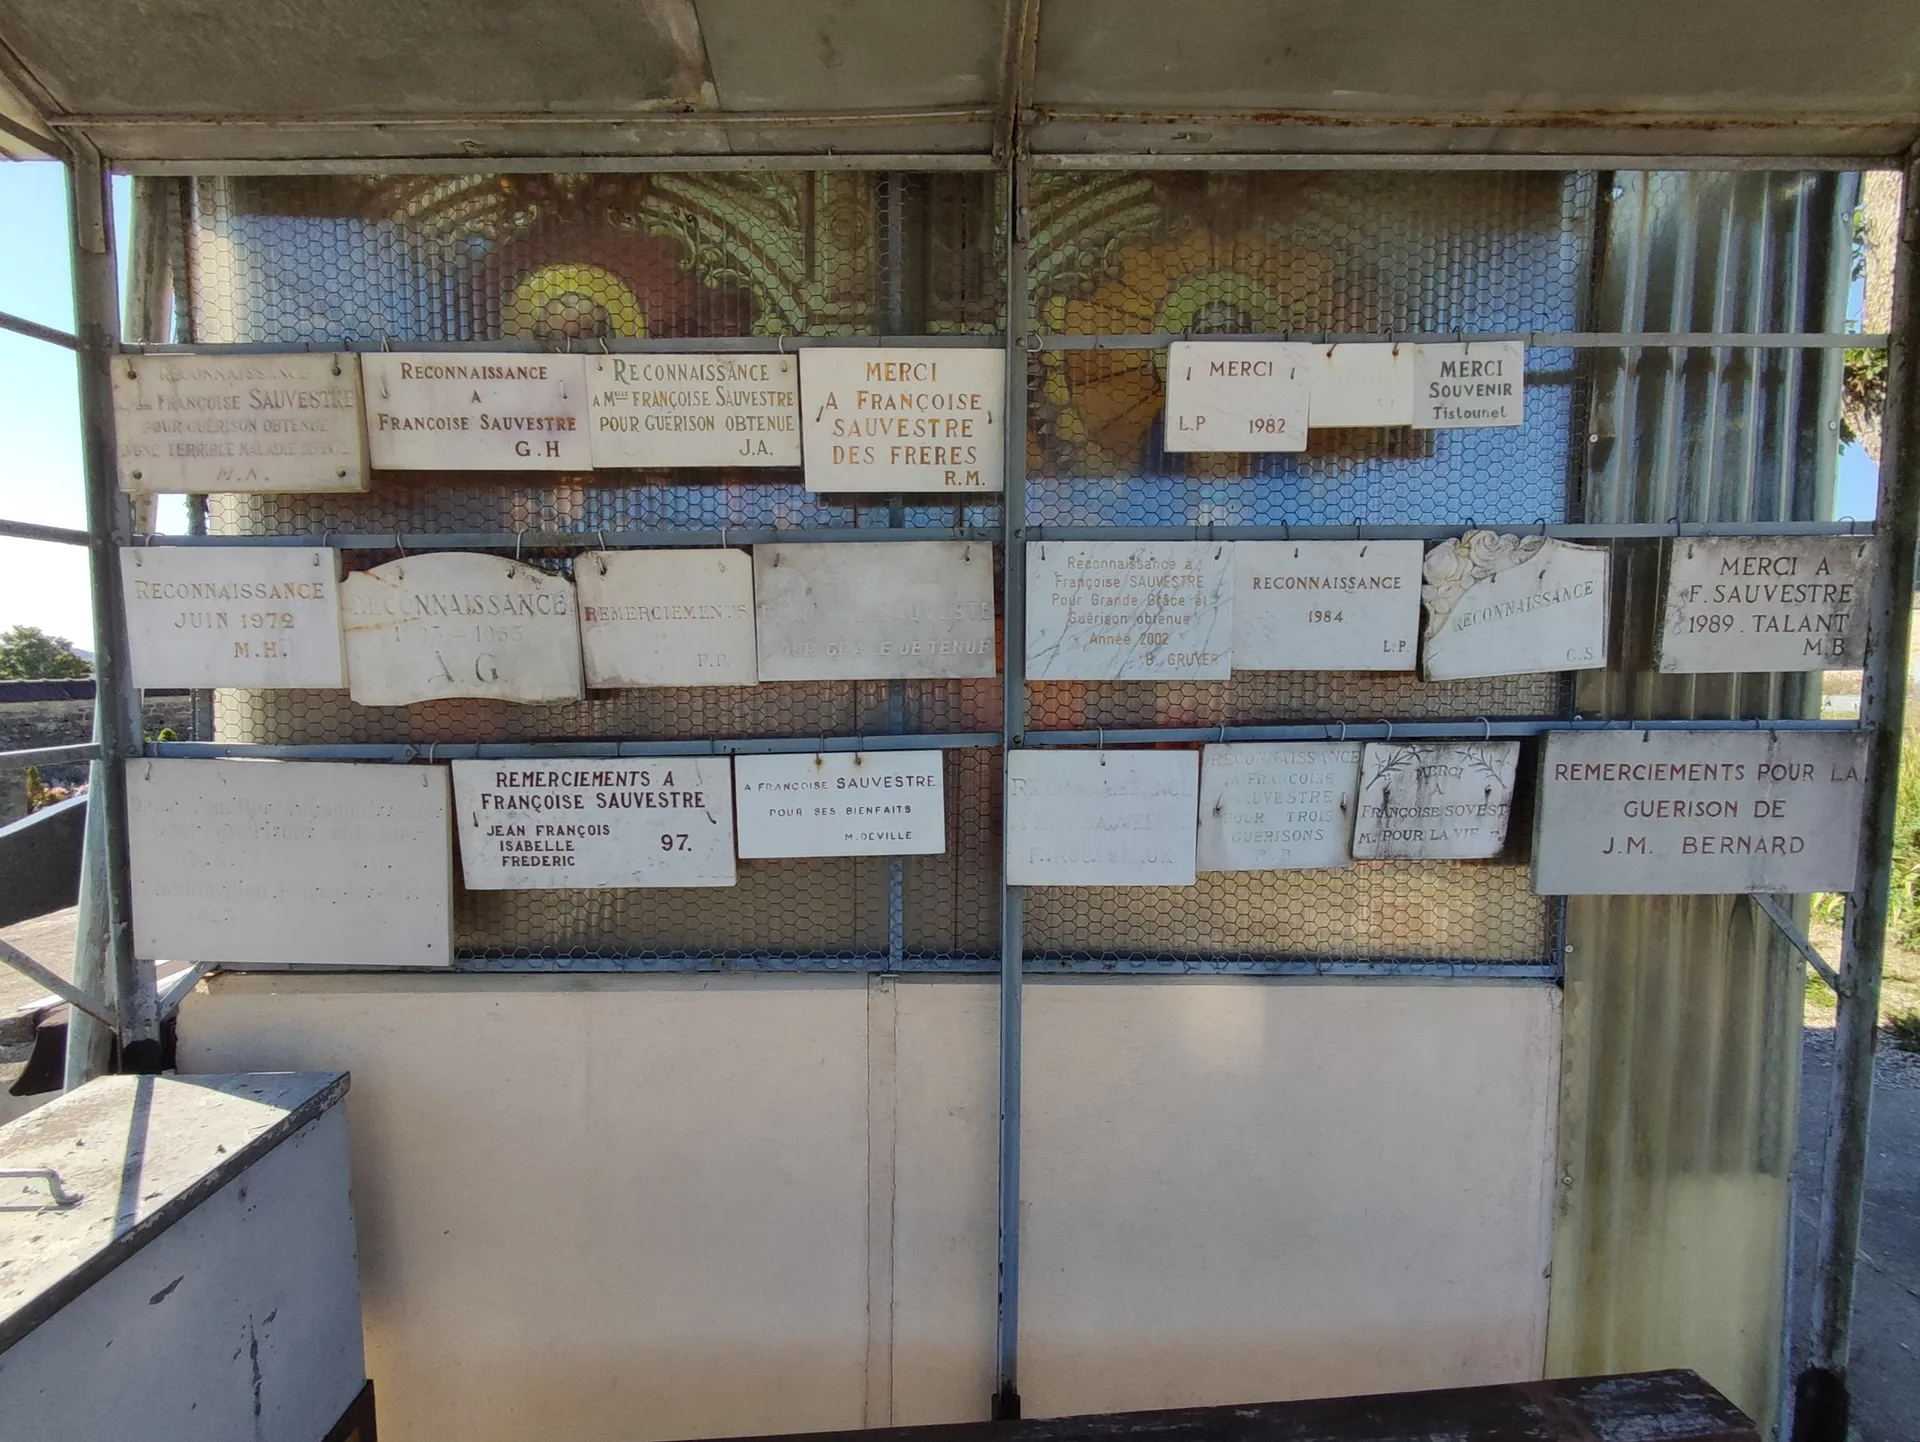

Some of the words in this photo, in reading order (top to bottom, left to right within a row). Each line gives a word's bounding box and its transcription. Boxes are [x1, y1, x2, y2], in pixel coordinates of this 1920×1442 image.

[400, 362, 548, 380] RECONNAISSANCE
[613, 358, 770, 385] RECONNAISSANCE
[866, 361, 937, 382] MERCI
[1209, 361, 1273, 377] MERCI
[1439, 360, 1503, 378] MERCI
[470, 389, 482, 404] A
[592, 394, 601, 407] A
[632, 390, 711, 411] FRANÇOISE
[715, 385, 794, 408] SAUVESTRE
[1428, 381, 1513, 399] SOUVENIR
[249, 388, 355, 411] SAUVESTRE
[825, 391, 838, 411] A
[856, 389, 982, 413] FRANÇOISE
[377, 412, 470, 434] FRANÇOISE
[480, 413, 577, 431] SAUVESTRE
[600, 415, 640, 433] POUR
[725, 415, 794, 432] OBTENUE
[832, 418, 974, 438] SAUVESTRE
[1249, 418, 1286, 434] 1982
[168, 442, 234, 458] TERRIBLE
[738, 438, 773, 456] J.A.
[832, 445, 876, 465] DES
[890, 441, 978, 466] FRÈRES
[944, 470, 987, 486] R.M.
[1067, 556, 1176, 570] Reconnaissance
[1184, 557, 1193, 570] à
[1719, 556, 1799, 576] MERCI
[1814, 556, 1831, 576] A
[135, 580, 325, 601] RECONNAISSANCE
[1054, 574, 1120, 590] Françoise
[1130, 576, 1205, 589] SAUVESTRE
[1252, 576, 1402, 590] RECONNAISSANCE
[352, 592, 568, 618] RECONNAISSANCE
[1052, 593, 1082, 606] Pour
[1091, 593, 1138, 606] Grande
[1195, 596, 1207, 606] et
[1453, 580, 1595, 632] RECONNAISSANCE
[174, 612, 228, 629] JUIN
[240, 612, 296, 629] 1972
[1069, 612, 1128, 625] Guérison
[1137, 612, 1190, 625] obtenue
[1308, 610, 1344, 623] 1984
[1752, 613, 1850, 633] TALANT
[1089, 632, 1132, 645] Année
[1140, 632, 1169, 645] 2002
[1211, 750, 1359, 766] RECONNAISSANCE
[495, 770, 650, 789] REMERCIEMENTS
[661, 770, 675, 787] A
[1416, 764, 1464, 779] MERCI
[1555, 763, 1745, 781] REMERCIEMENTS
[1757, 763, 1814, 781] POUR
[1830, 763, 1859, 782] LA
[744, 783, 752, 791] A
[836, 775, 936, 790] SAUVESTRE
[1011, 777, 1193, 797] RECONAISSANCE
[1429, 783, 1444, 796] A
[481, 793, 585, 813] FRANÇOISE
[596, 791, 706, 809] SAUVESTRE
[1230, 790, 1333, 804] SAUVESTRE
[769, 807, 803, 817] POUR
[813, 807, 837, 817] SES
[845, 805, 912, 816] BIENFAITS
[1224, 811, 1264, 824] POUR
[1286, 811, 1334, 822] TROIS
[1361, 804, 1439, 821] FRANÇOISE
[1624, 800, 1738, 818] GUERISON
[1754, 800, 1786, 818] DE
[486, 825, 526, 838] JEAN
[535, 824, 612, 841] FRANÇOIS
[1382, 829, 1424, 842] POUR
[1429, 828, 1448, 841] LA
[1453, 827, 1479, 840] VIE
[499, 840, 576, 853] ISABELLE
[1682, 836, 1805, 854] BERNARD
[502, 855, 577, 868] FREDERIC
